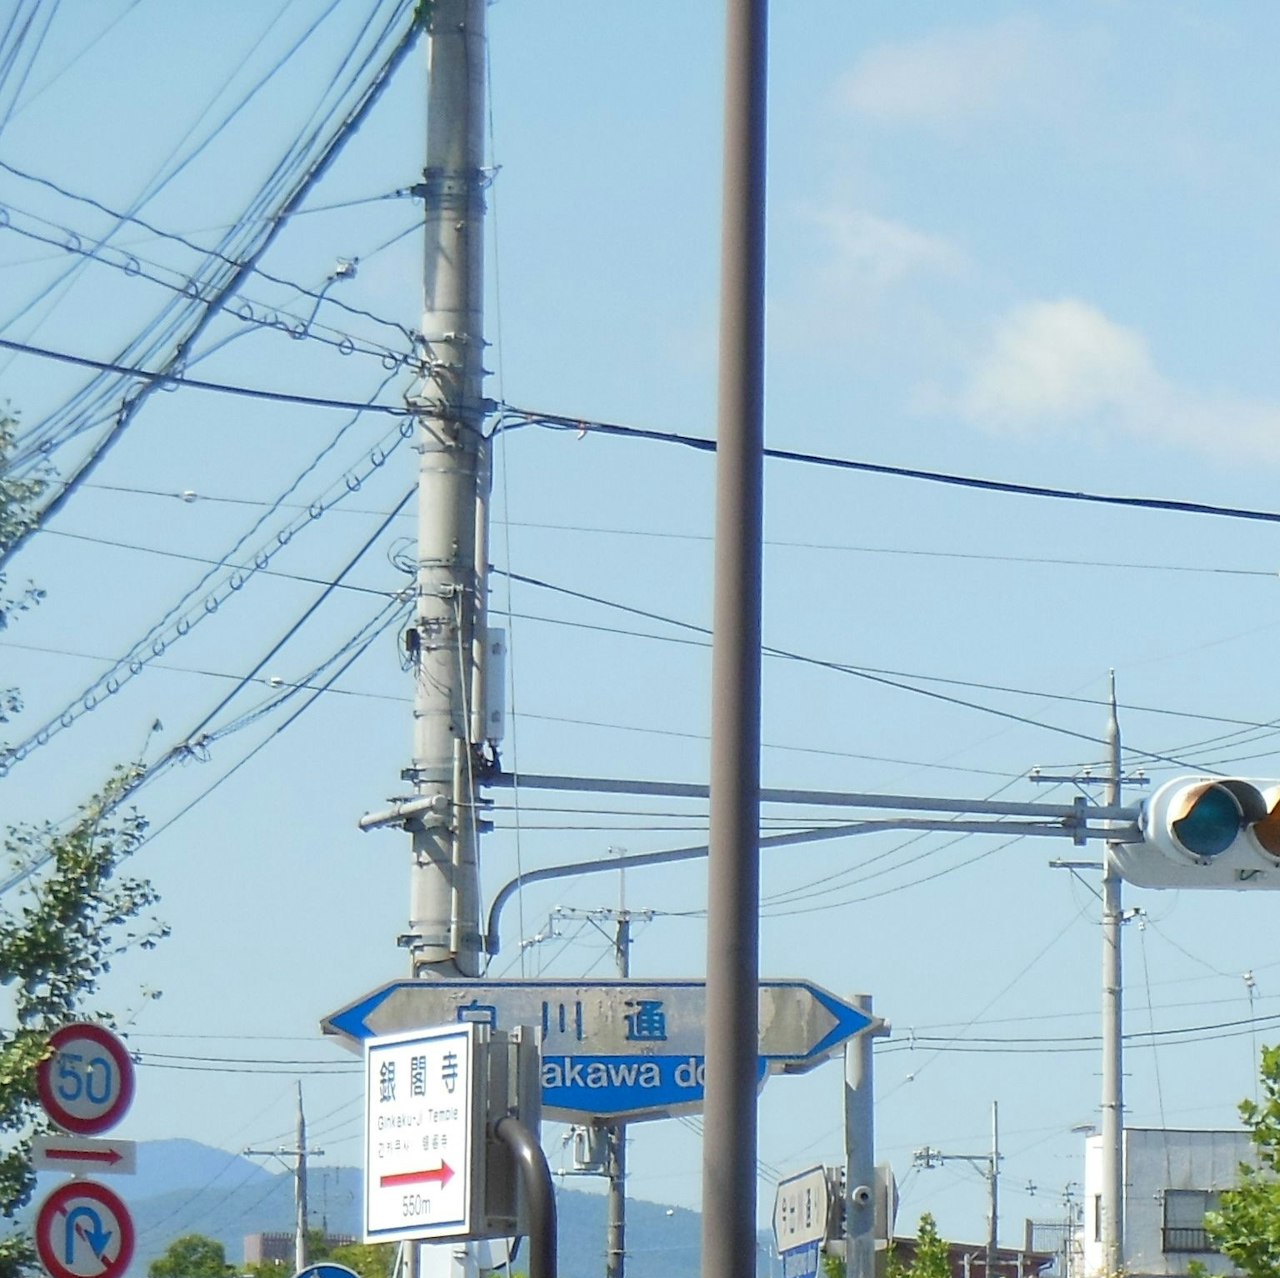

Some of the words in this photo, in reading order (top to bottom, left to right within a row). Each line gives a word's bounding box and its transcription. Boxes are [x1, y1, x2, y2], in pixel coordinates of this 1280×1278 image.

[57, 1053, 113, 1105] 50
[379, 1051, 459, 1103] 銀閣寺
[428, 1107, 459, 1123] Temple
[402, 1195, 431, 1217] 550m
